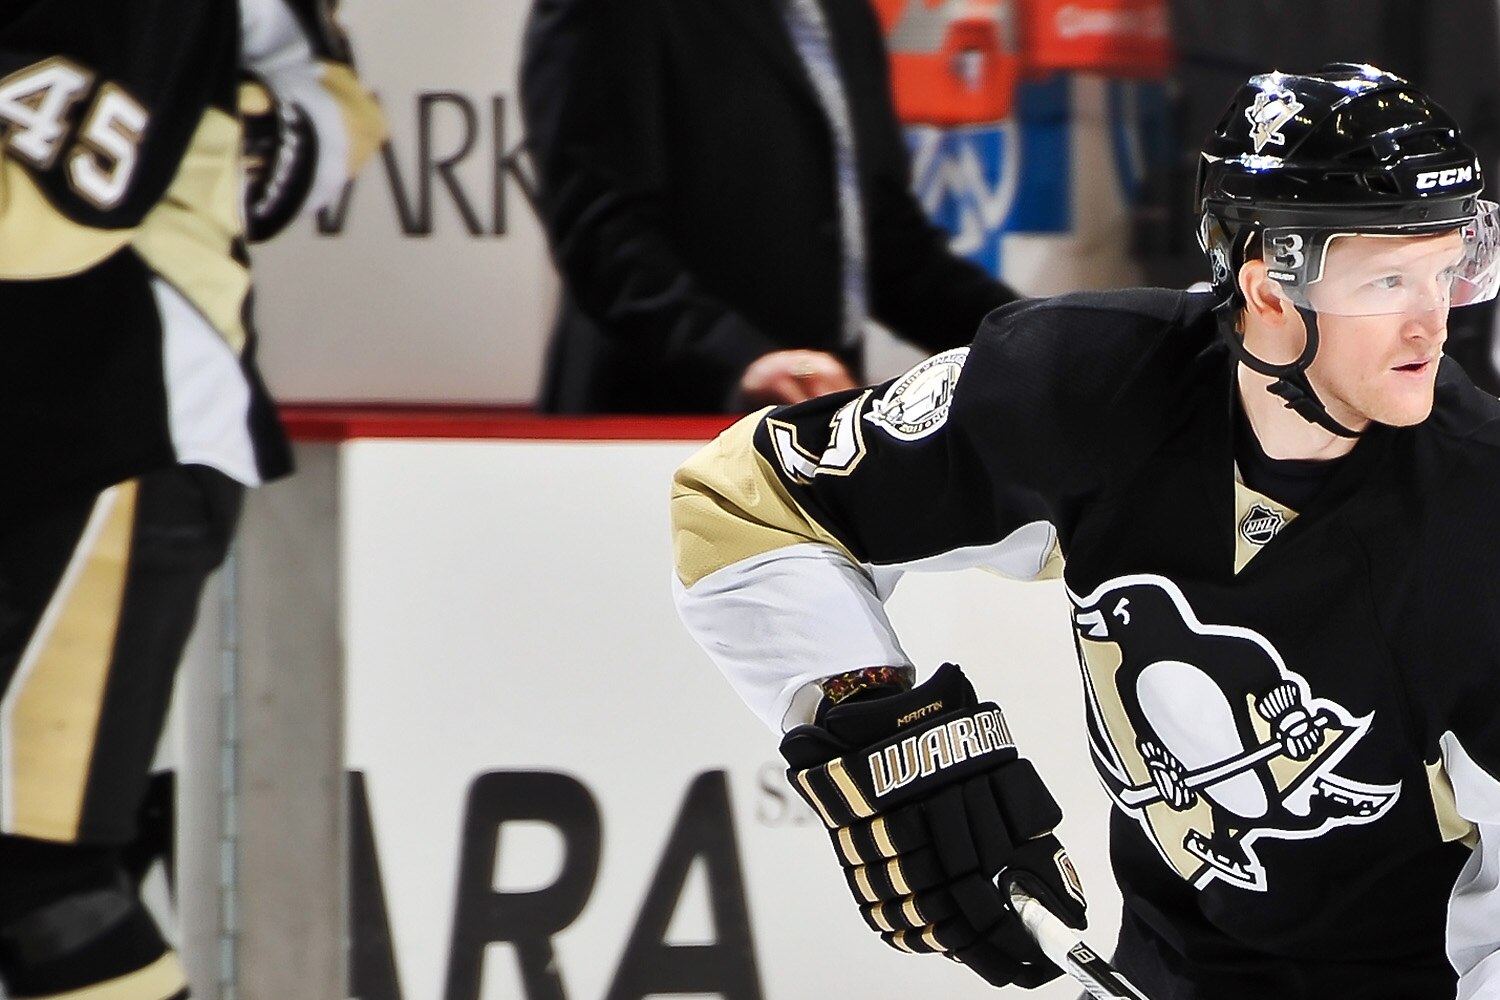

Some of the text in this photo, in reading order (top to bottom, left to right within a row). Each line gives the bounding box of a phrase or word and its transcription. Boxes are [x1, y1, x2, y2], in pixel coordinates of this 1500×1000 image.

[0, 58, 150, 210] 45
[1415, 165, 1473, 191] CCM
[896, 700, 944, 728] MARTIN
